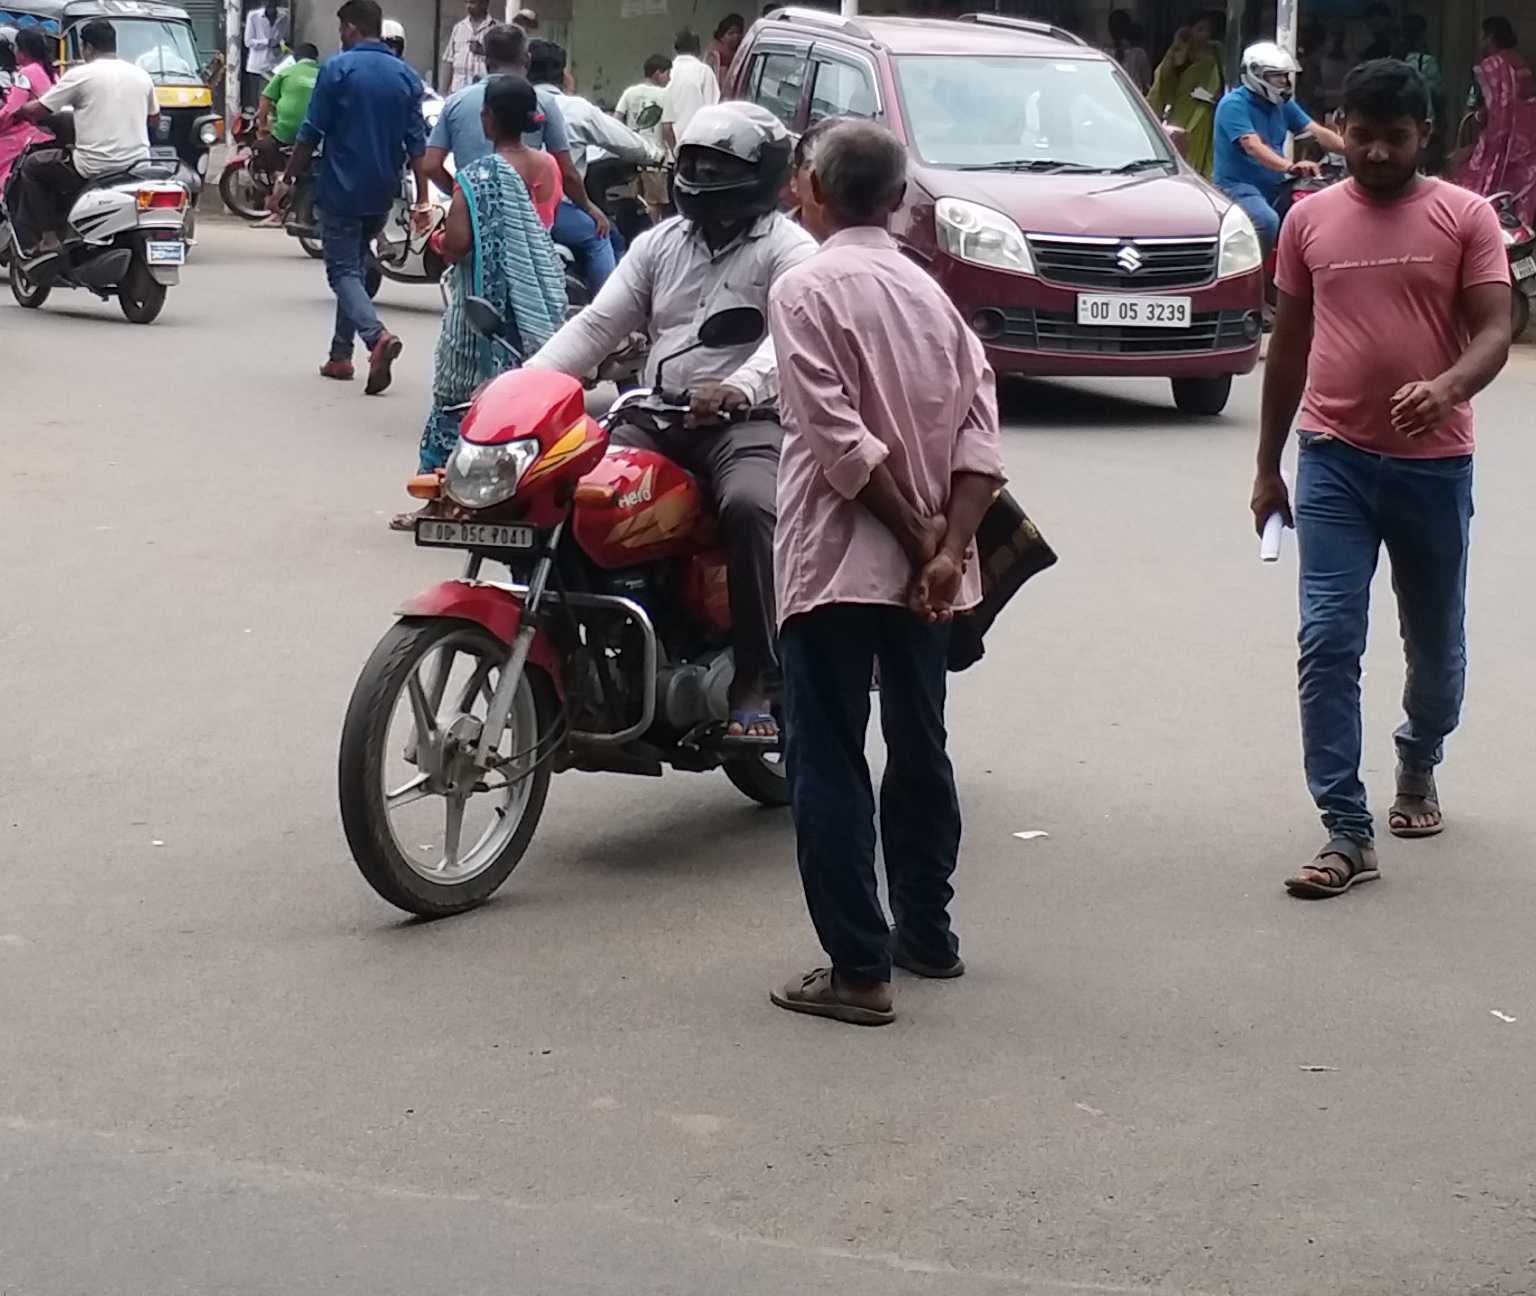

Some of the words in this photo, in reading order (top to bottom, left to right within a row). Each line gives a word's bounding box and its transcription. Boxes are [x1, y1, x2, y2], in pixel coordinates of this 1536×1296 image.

[1091, 301, 1110, 320] OD
[1119, 302, 1138, 321] 05
[1146, 304, 1185, 322] 3239
